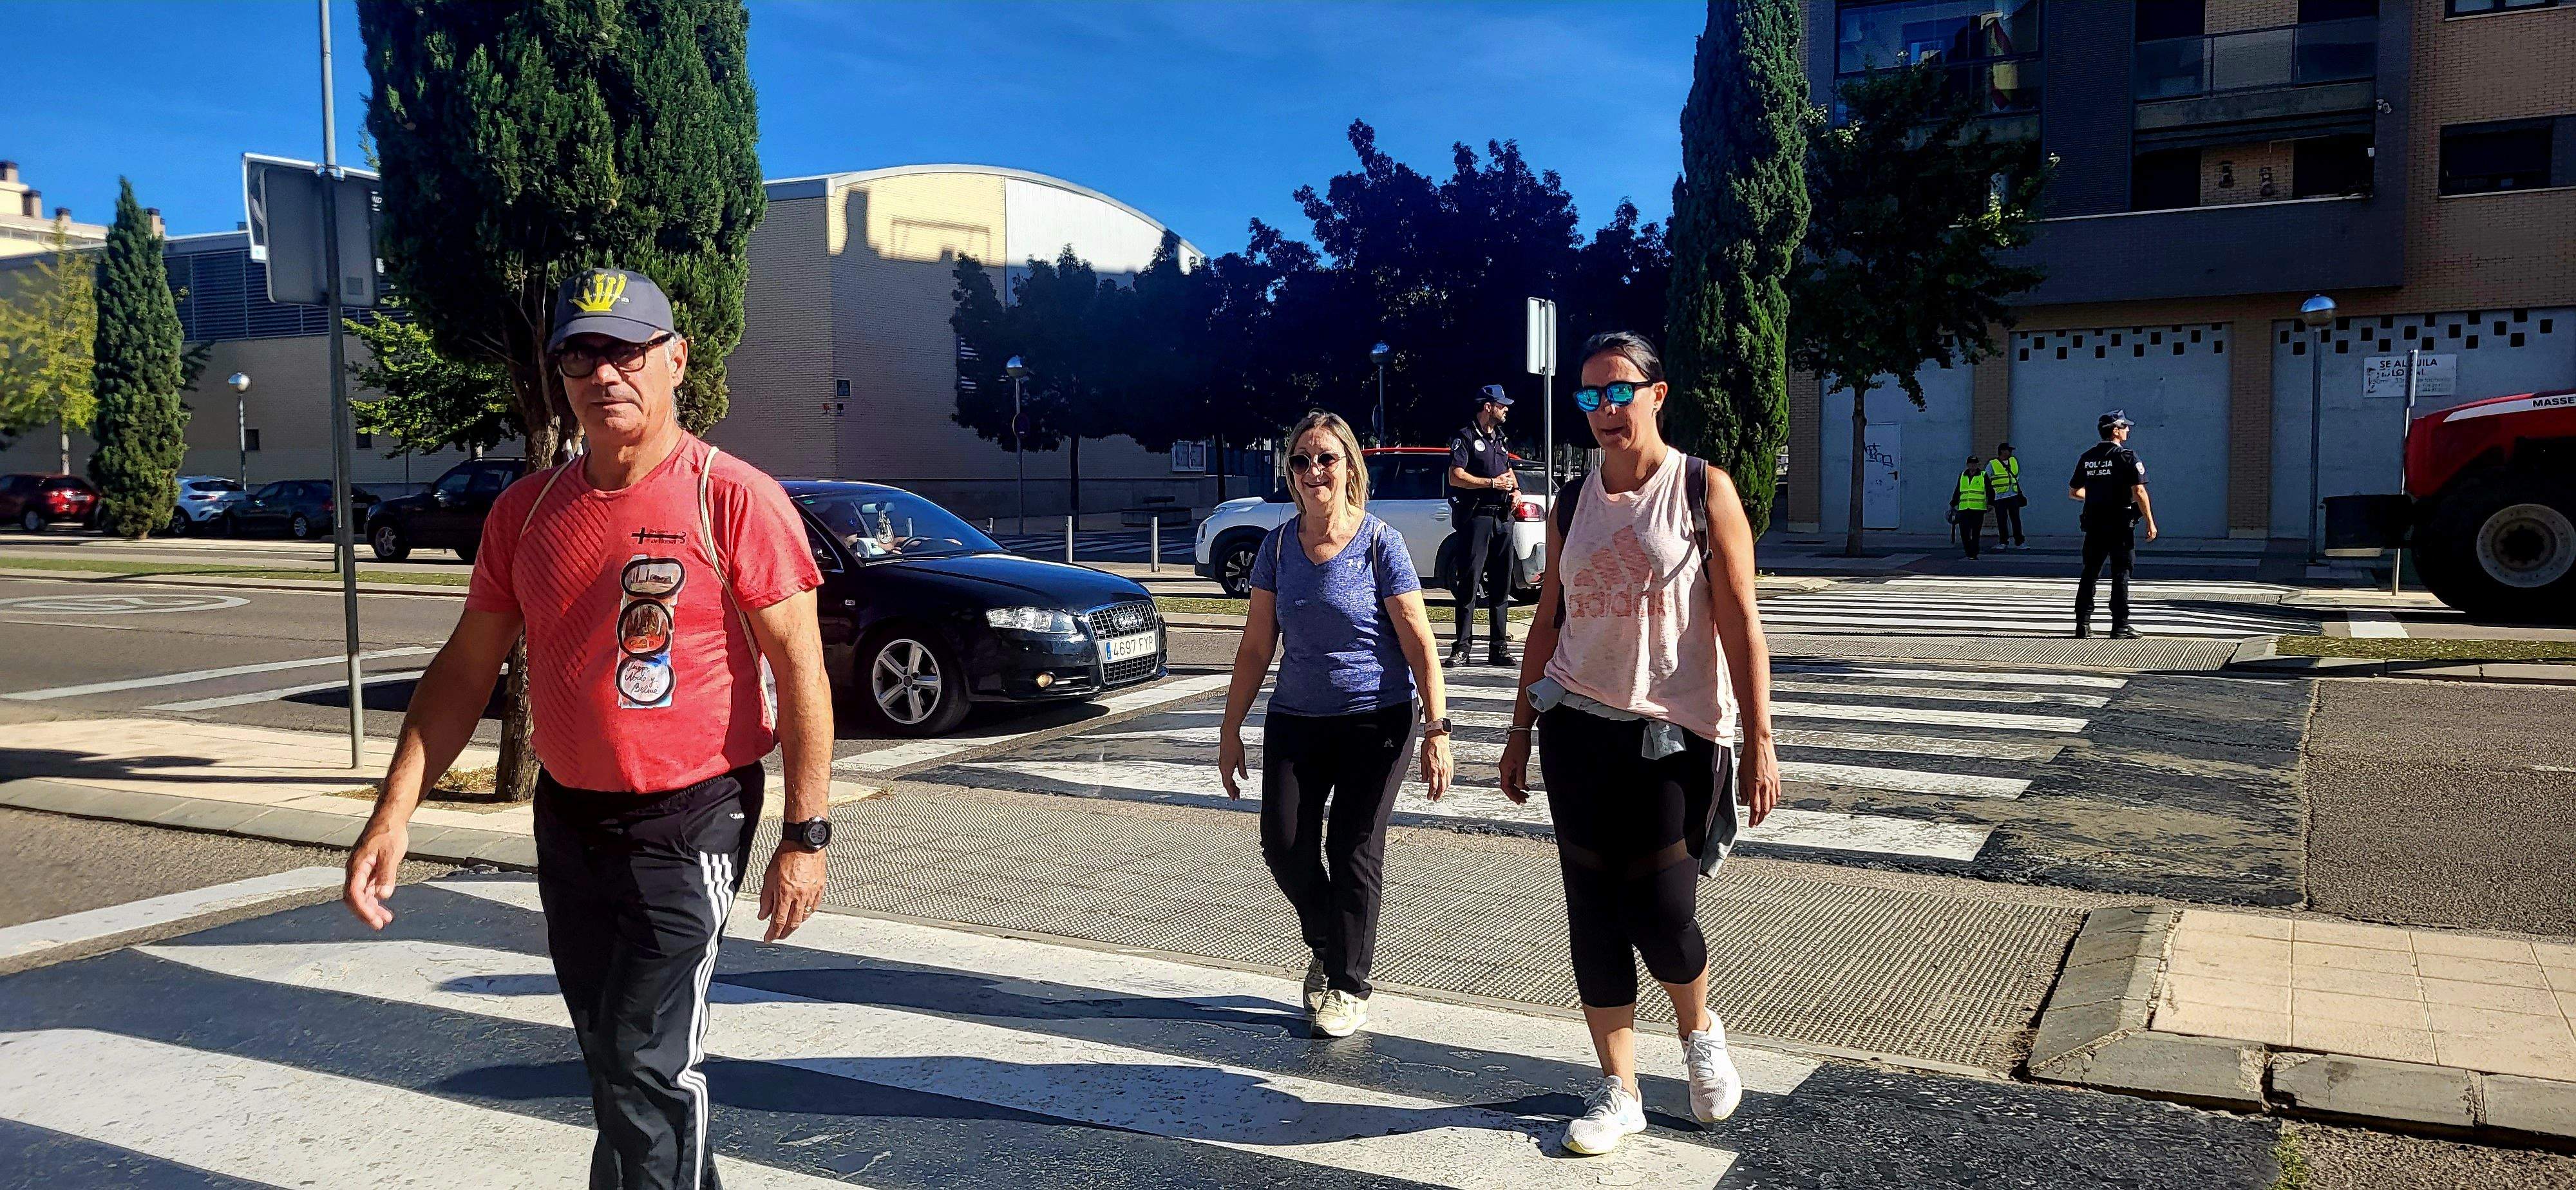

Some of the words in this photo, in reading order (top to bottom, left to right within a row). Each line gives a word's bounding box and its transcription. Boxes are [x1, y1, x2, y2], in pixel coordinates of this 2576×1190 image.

[2394, 358, 2438, 367] ALUILA
[1113, 639, 1136, 657] 4697
[1139, 636, 1153, 652] FYP
